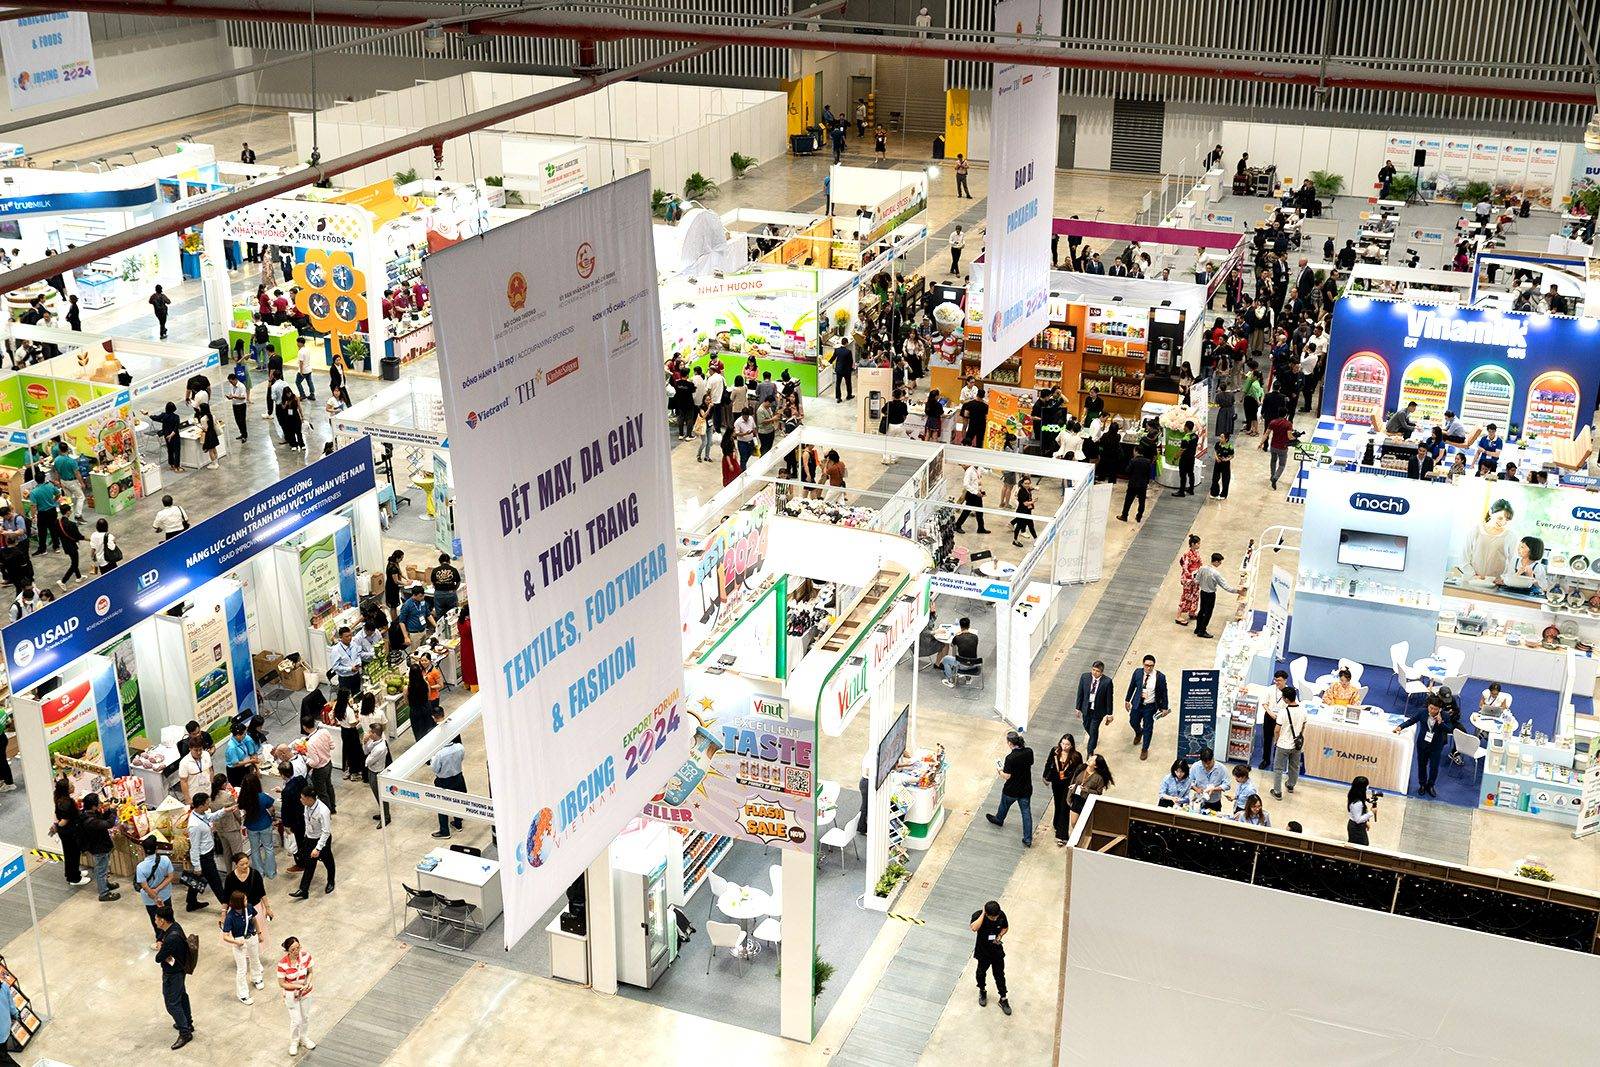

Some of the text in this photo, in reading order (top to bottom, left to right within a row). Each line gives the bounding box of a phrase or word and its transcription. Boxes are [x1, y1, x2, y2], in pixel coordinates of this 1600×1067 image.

[39, 32, 63, 47] FOODS
[63, 66, 91, 81] 2024
[1007, 198, 1038, 234] PACKAGING
[298, 232, 346, 244] FANCY FOODS
[515, 378, 536, 404] TH
[478, 397, 510, 422] Vietravel
[499, 413, 644, 537] DỆT MAY, DA GIÀY
[256, 500, 267, 515] ÁN
[267, 491, 287, 509] TĂNG
[286, 478, 313, 500] CƯỜNG
[1355, 494, 1404, 514] inochi
[186, 550, 211, 568] NĂNG
[210, 540, 225, 556] LỰC
[226, 528, 247, 548] CẠNH
[248, 516, 273, 537] TRANH
[273, 507, 289, 522] KHU
[288, 497, 306, 512] VỰC
[304, 490, 316, 505] TƯ
[314, 480, 335, 500] NHÂN
[334, 471, 350, 489] VIỆT
[349, 463, 366, 479] NAM
[523, 492, 640, 602] & THỜI TRANG
[939, 583, 960, 591] COMPANY
[33, 616, 80, 650] USAID
[502, 542, 668, 699] TEXTILES, FOOTWEAR
[551, 636, 636, 733] & FASHION
[838, 654, 868, 720] Vinut
[80, 707, 92, 717] FARM
[623, 688, 680, 748] EXPORT FORUM
[753, 700, 784, 720] Vinut
[733, 716, 801, 738] EXCELLENT
[624, 704, 681, 781] 2024
[722, 726, 812, 768] TASTE
[1335, 750, 1378, 764] TANPHU
[744, 804, 786, 820] FLASH
[746, 819, 789, 839] SALE
[789, 831, 805, 839] NOW
